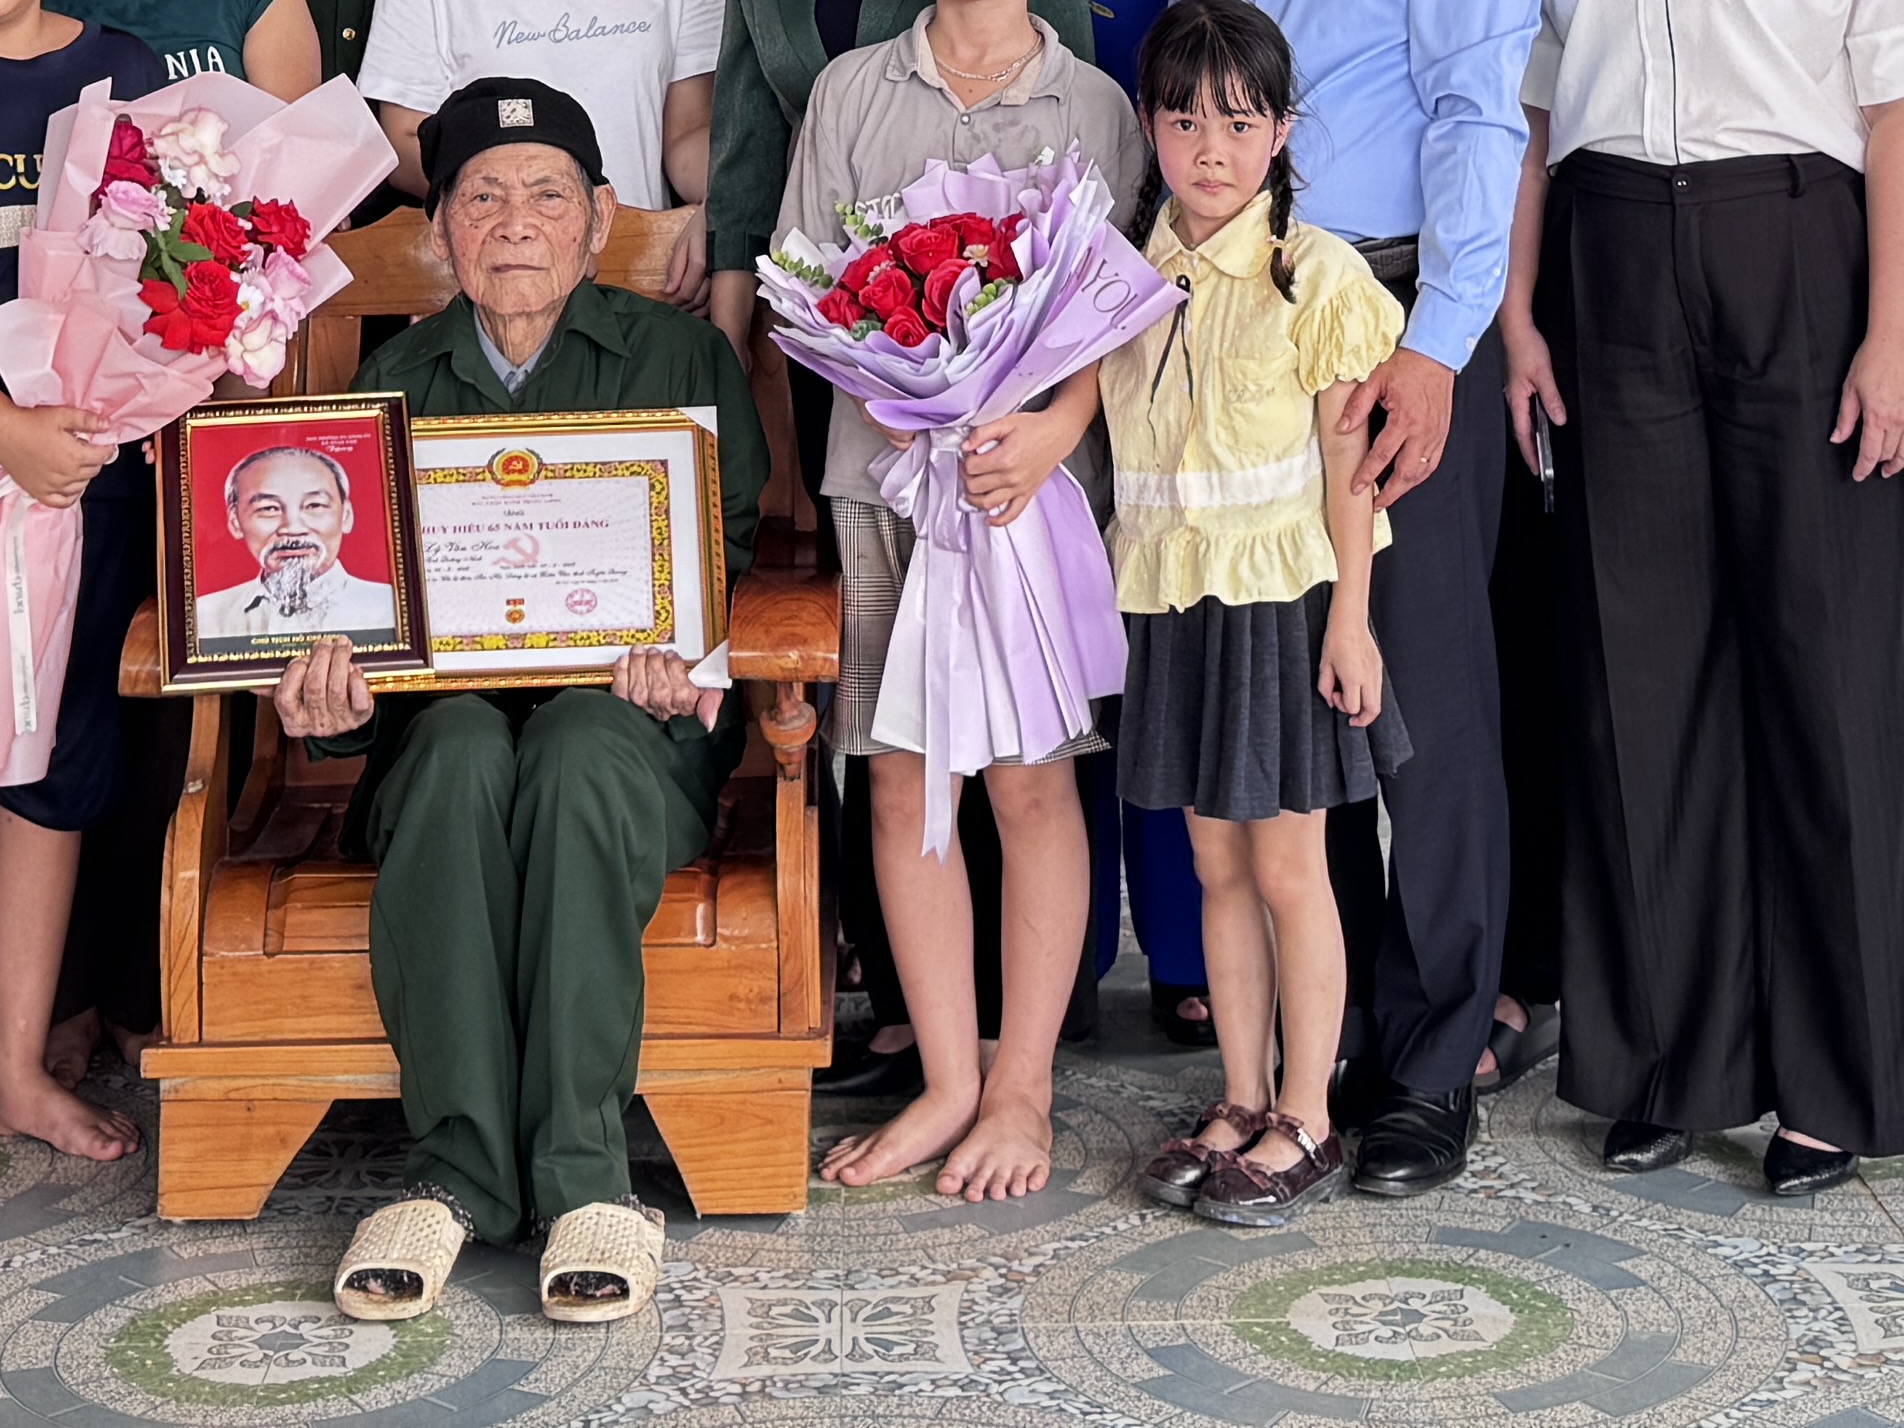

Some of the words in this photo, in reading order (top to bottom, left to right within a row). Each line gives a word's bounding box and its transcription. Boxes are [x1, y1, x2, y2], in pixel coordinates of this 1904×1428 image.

[495, 20, 545, 48] New
[549, 12, 652, 44] Balance
[421, 525, 448, 535] HUY
[487, 522, 501, 533] 65
